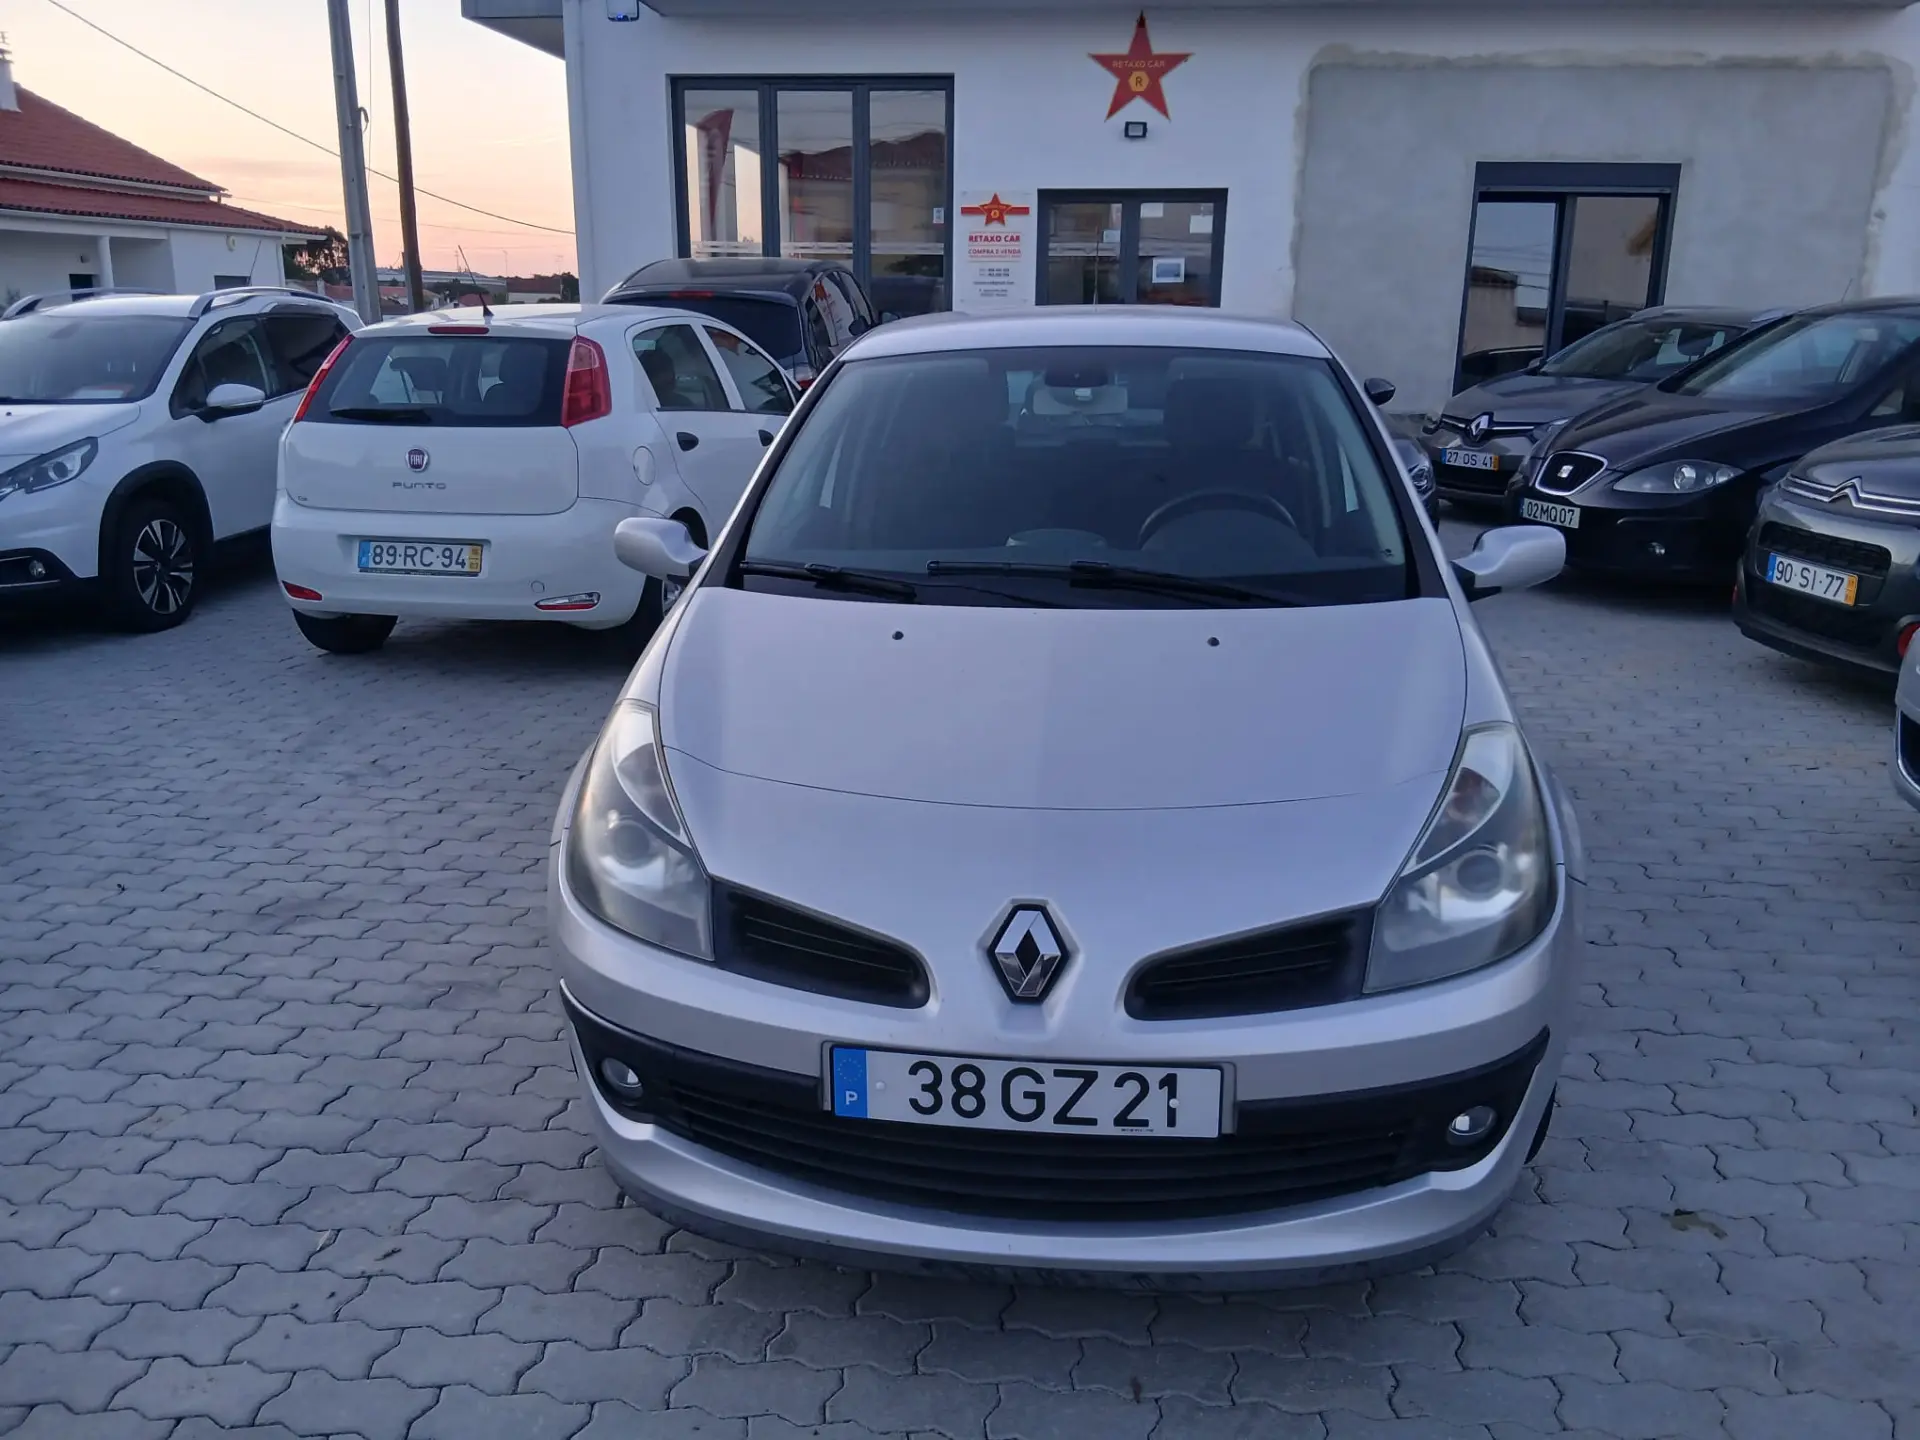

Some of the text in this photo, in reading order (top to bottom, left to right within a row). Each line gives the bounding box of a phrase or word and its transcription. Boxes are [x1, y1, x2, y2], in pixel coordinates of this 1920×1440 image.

[1112, 60, 1165, 68] RETAXO CAR
[1135, 76, 1143, 87] R
[410, 454, 423, 465] FIAT
[392, 482, 447, 490] PUNTO
[844, 1090, 858, 1106] P
